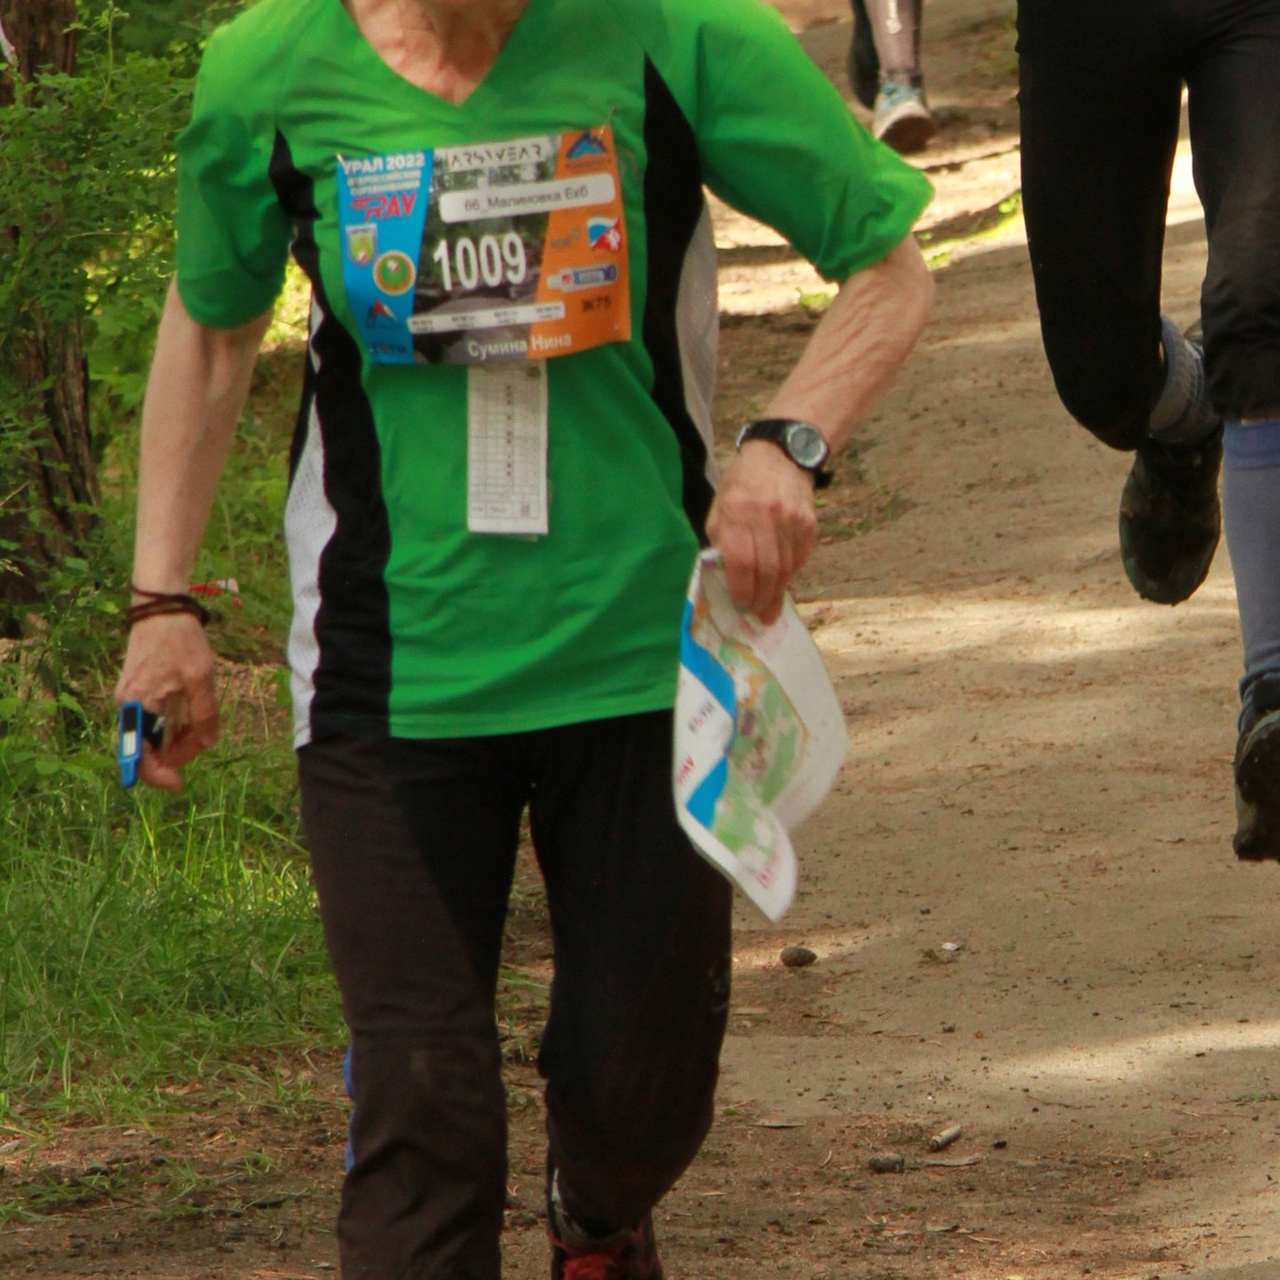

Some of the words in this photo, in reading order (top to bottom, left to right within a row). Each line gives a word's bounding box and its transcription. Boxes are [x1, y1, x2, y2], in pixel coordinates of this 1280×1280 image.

[343, 157, 384, 175] УРАЛ
[386, 152, 426, 170] 2022
[351, 190, 418, 221] RAV
[564, 184, 589, 201] Екб
[432, 233, 527, 291] 1009
[467, 339, 528, 360] Сумина
[531, 333, 572, 351] Нина
